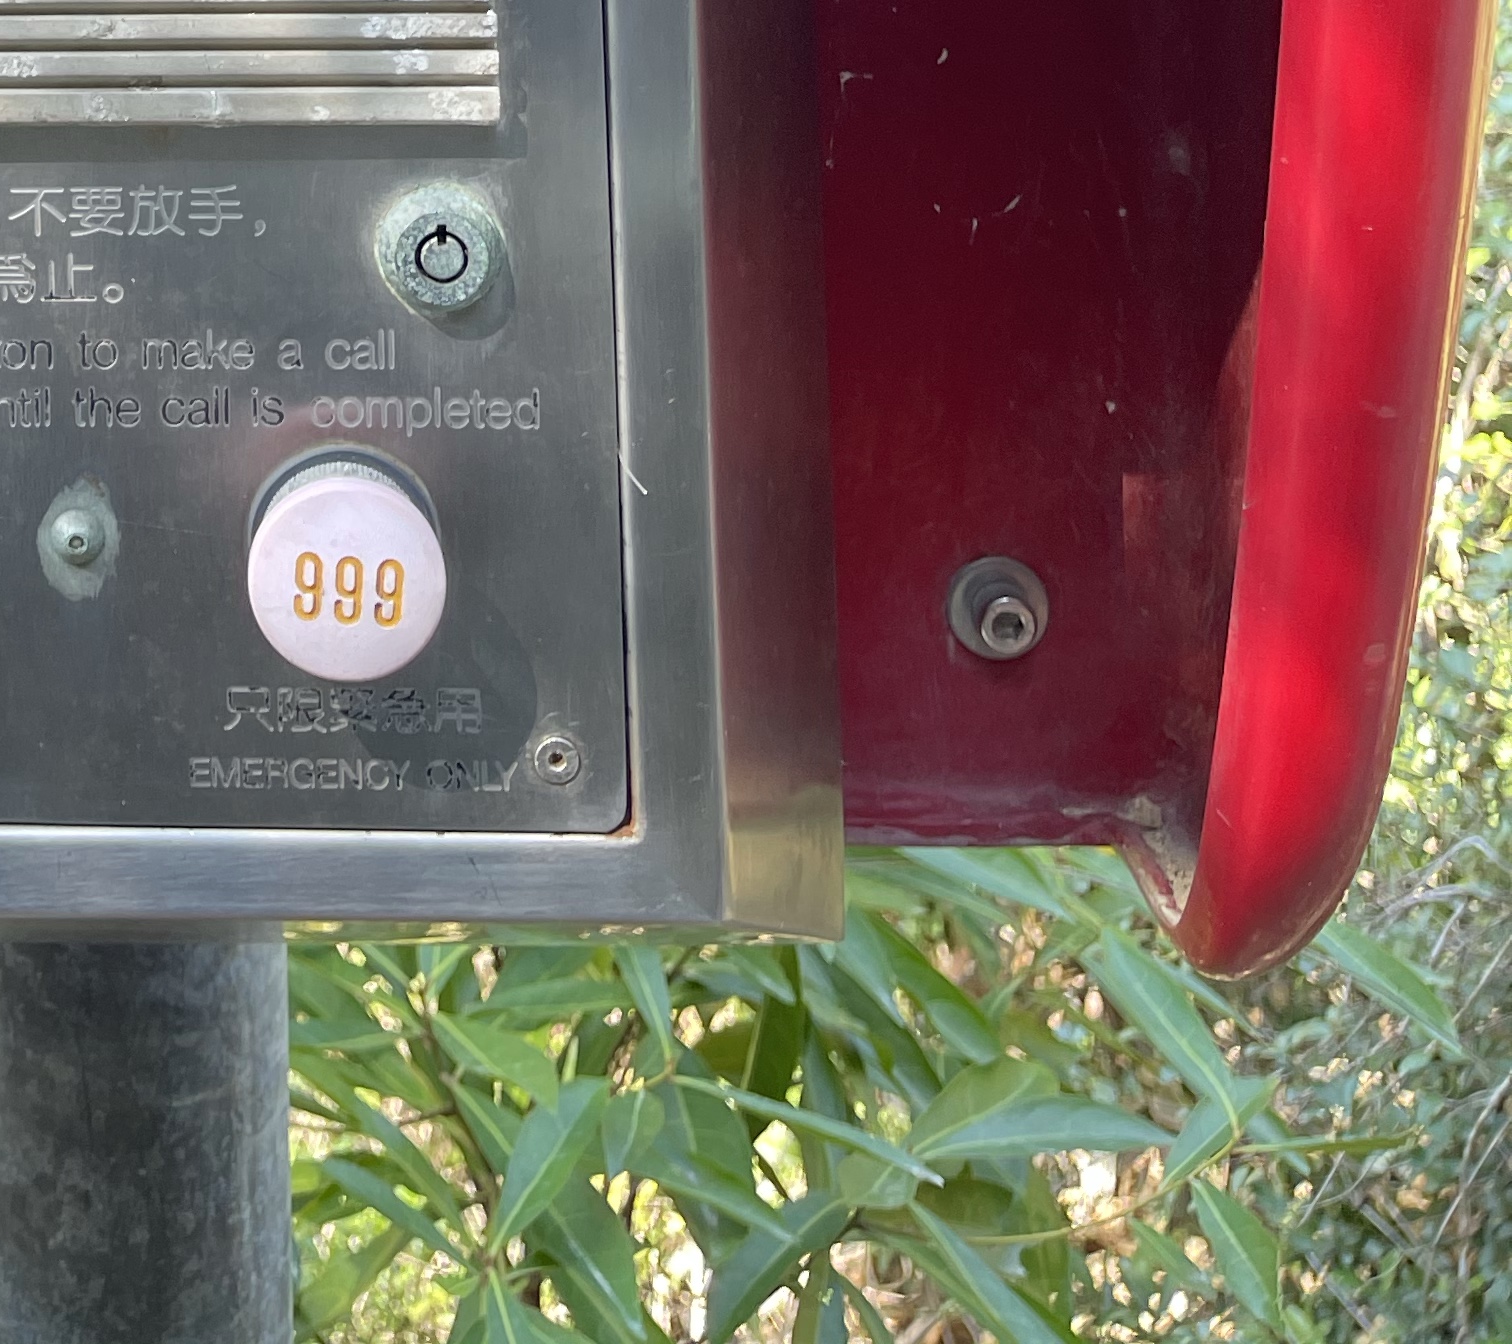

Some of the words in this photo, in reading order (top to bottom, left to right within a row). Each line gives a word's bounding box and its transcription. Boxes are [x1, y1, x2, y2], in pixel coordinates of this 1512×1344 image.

[78, 329, 119, 370] to
[142, 328, 255, 370] make
[277, 338, 304, 370] a
[324, 328, 395, 370] call
[73, 386, 141, 428] the
[161, 386, 230, 427] call
[251, 386, 286, 428] is
[310, 386, 541, 437] completed
[293, 550, 405, 627] 999
[189, 756, 410, 791] EMERGENCY
[426, 759, 518, 792] ONLY
